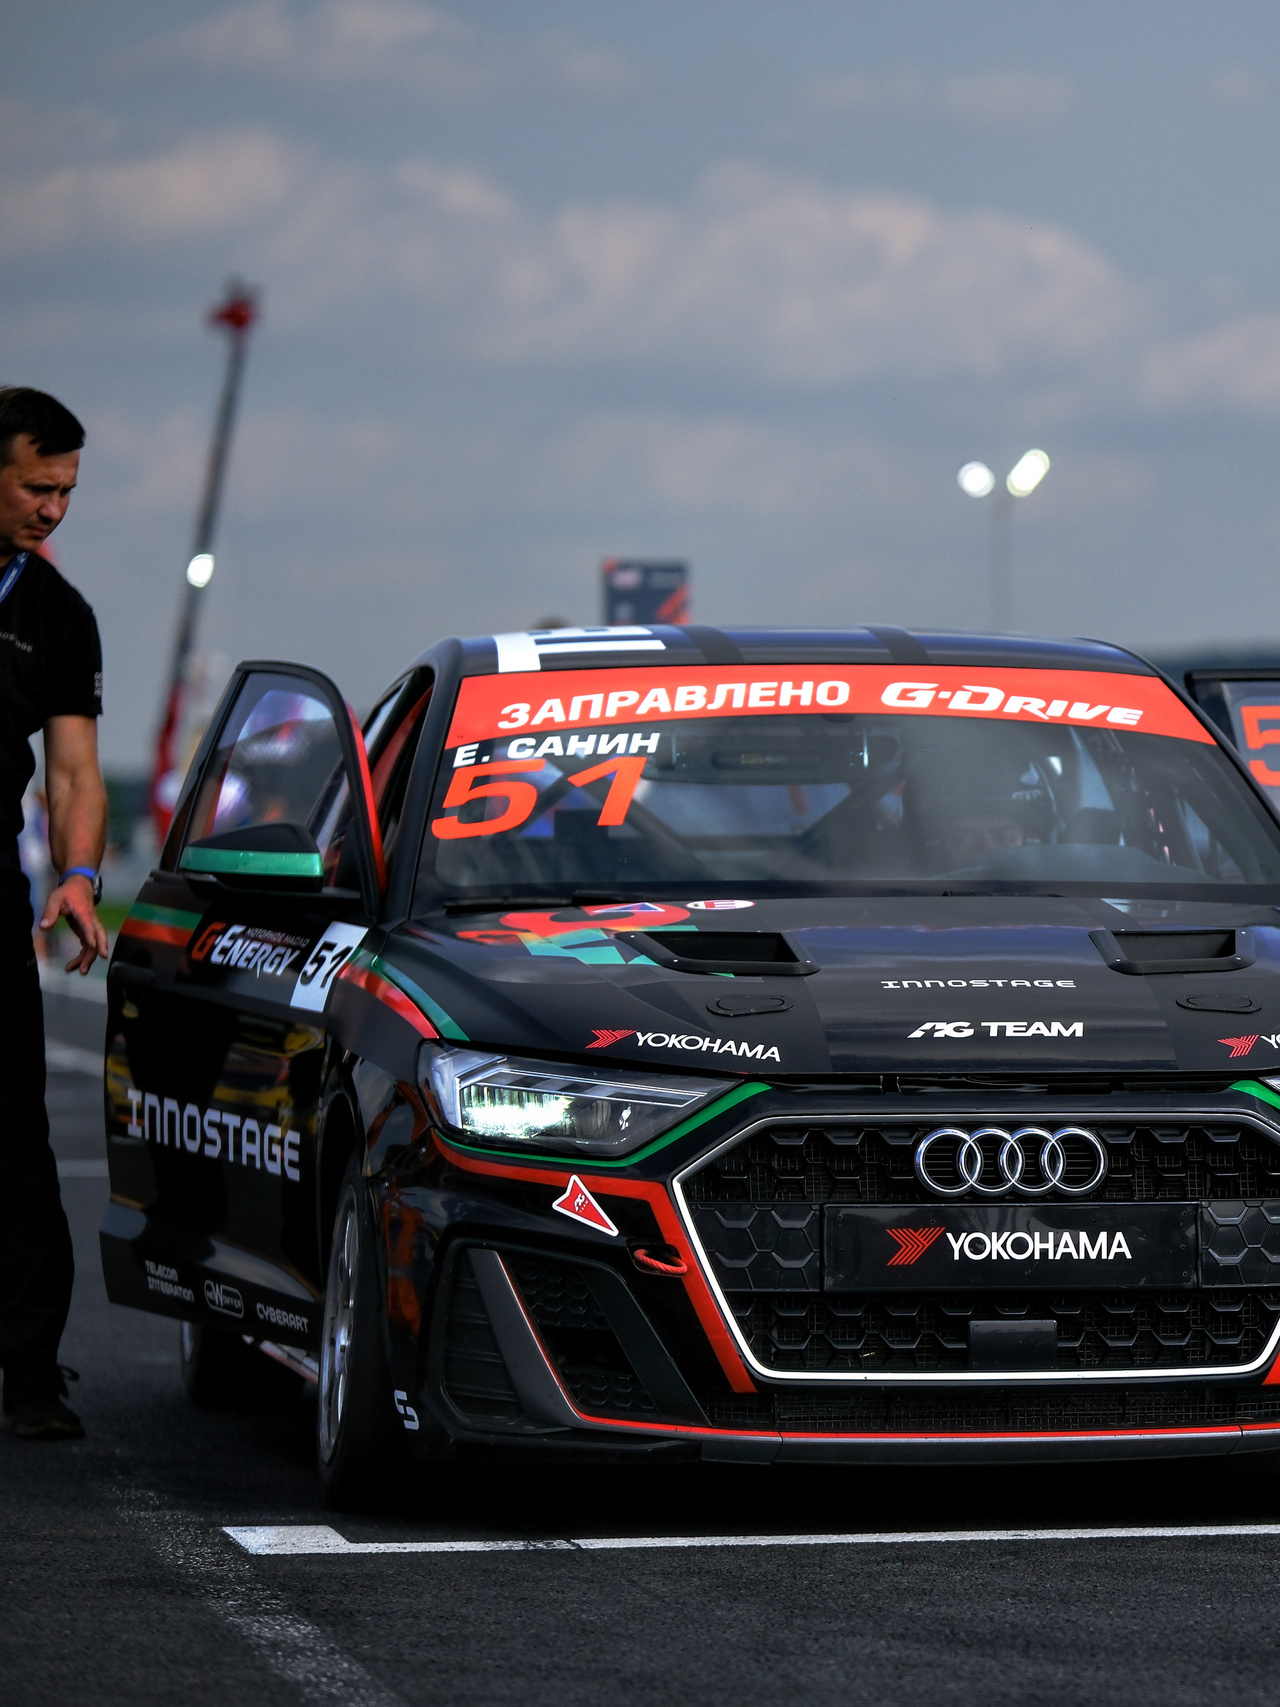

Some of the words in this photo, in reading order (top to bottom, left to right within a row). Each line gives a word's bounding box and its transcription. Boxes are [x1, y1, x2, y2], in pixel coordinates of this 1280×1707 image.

[498, 681, 851, 729] ЗАПРАВЛЕНО
[453, 743, 489, 768] Е.
[507, 733, 660, 760] САНИН
[431, 757, 647, 840] 51
[300, 940, 353, 989] 51
[881, 978, 1077, 989] INNOSTAGE
[981, 1021, 1084, 1038] TEAM
[634, 1031, 782, 1062] YOKOHAMA
[127, 1088, 300, 1182] INNOSTAGE
[945, 1231, 1132, 1260] YOKOHAMA
[256, 1302, 309, 1333] CYBERART
